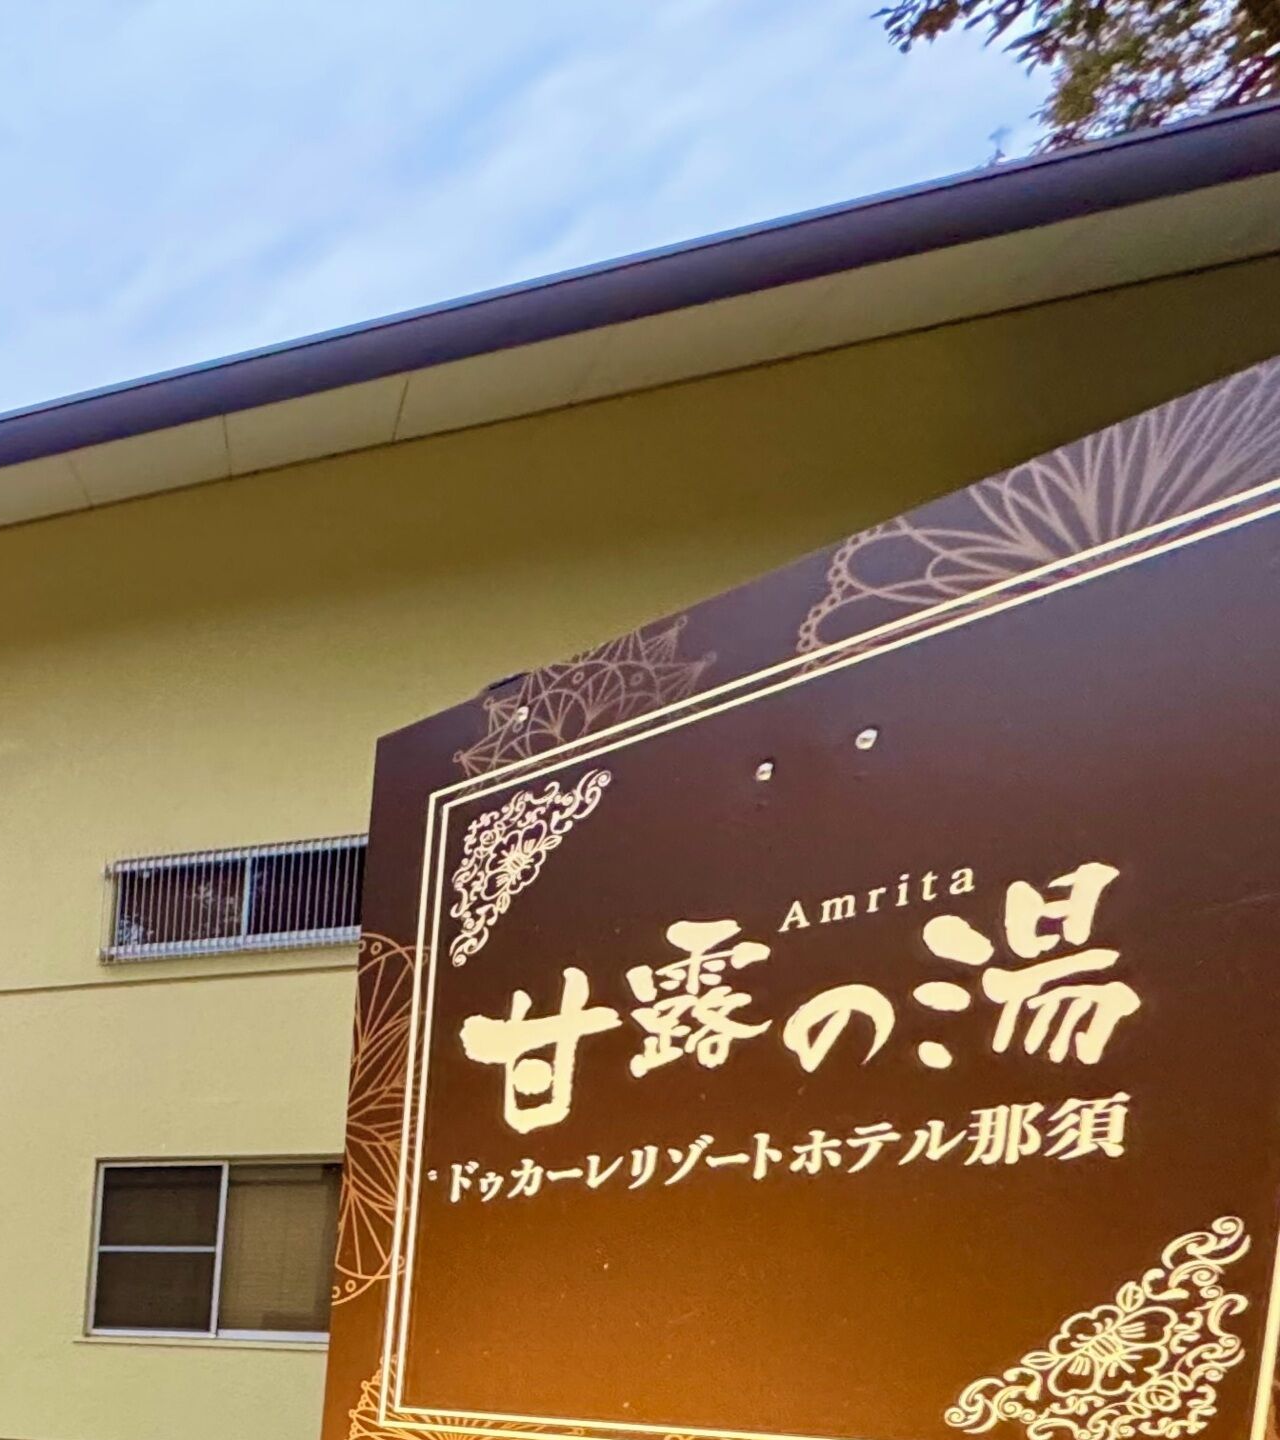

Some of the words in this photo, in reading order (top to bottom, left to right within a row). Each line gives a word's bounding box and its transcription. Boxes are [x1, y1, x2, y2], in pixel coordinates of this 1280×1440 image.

[778, 866, 976, 932] Amrita
[460, 862, 1141, 1134] 甘露の湯
[449, 1092, 1131, 1203] ドゥカーレリゾートホテル那須
